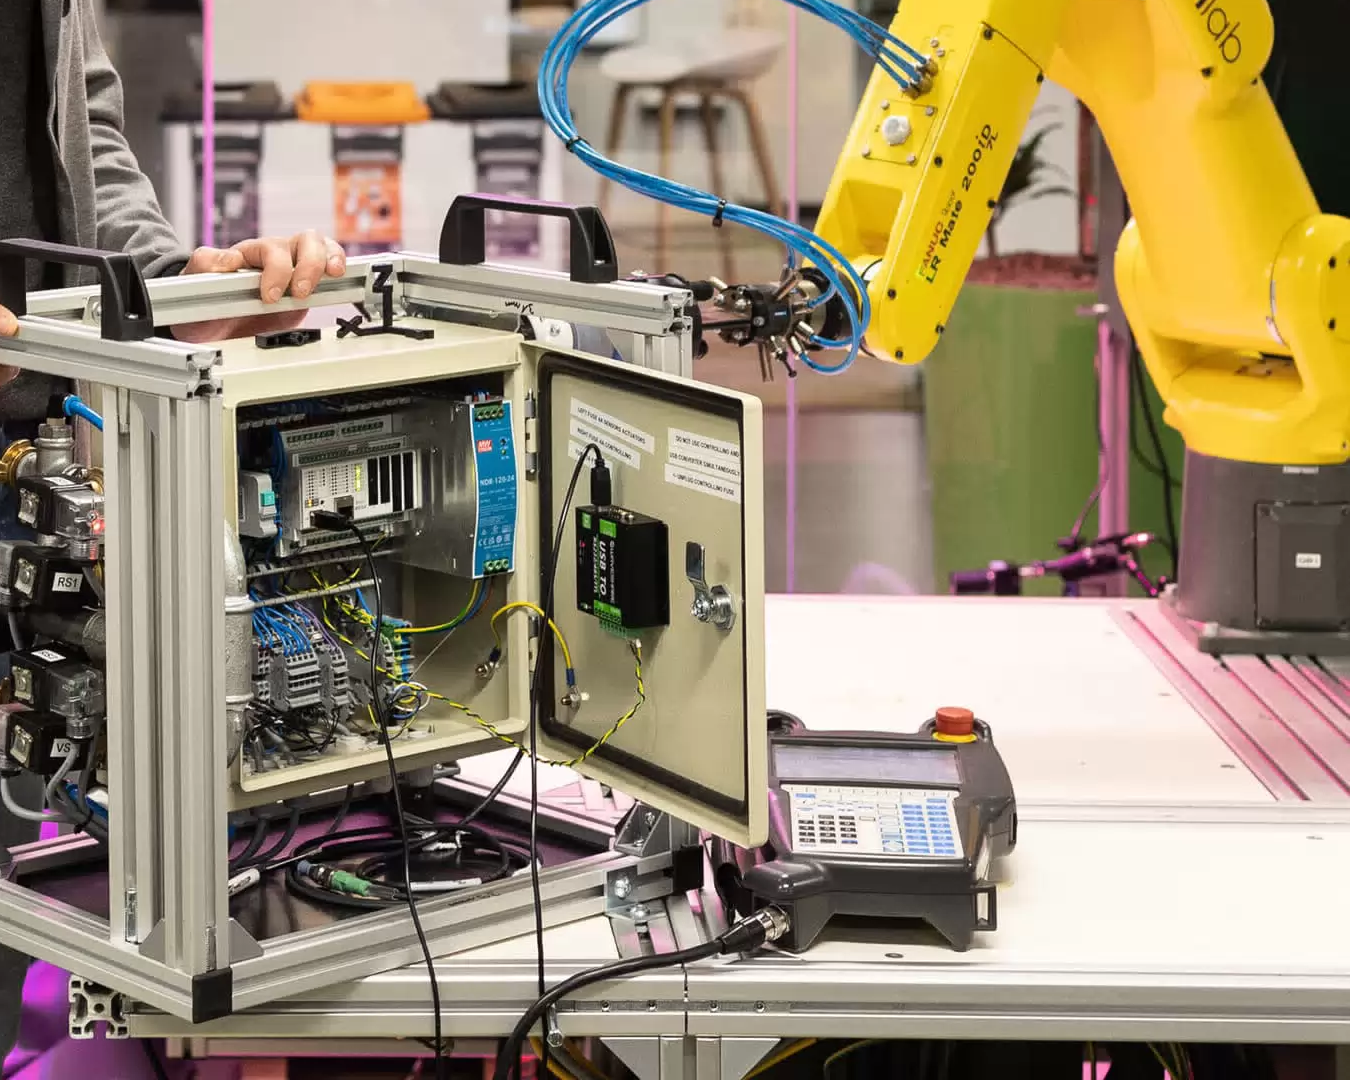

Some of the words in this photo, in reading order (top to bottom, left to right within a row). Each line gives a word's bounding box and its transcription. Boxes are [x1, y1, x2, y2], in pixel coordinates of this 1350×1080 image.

[986, 131, 999, 151] 7L
[925, 255, 942, 284] LR
[939, 200, 963, 248] Mate
[961, 124, 992, 193] 200iD
[918, 221, 944, 277] FANUC
[621, 426, 646, 445] ACTUATORS
[700, 441, 730, 456] CONTROLLING
[703, 460, 740, 477] SIMULTANEOUSLY
[694, 478, 723, 492] CONTROLLING
[599, 540, 607, 571] USB
[57, 576, 78, 589] RS1
[599, 576, 607, 596] TO
